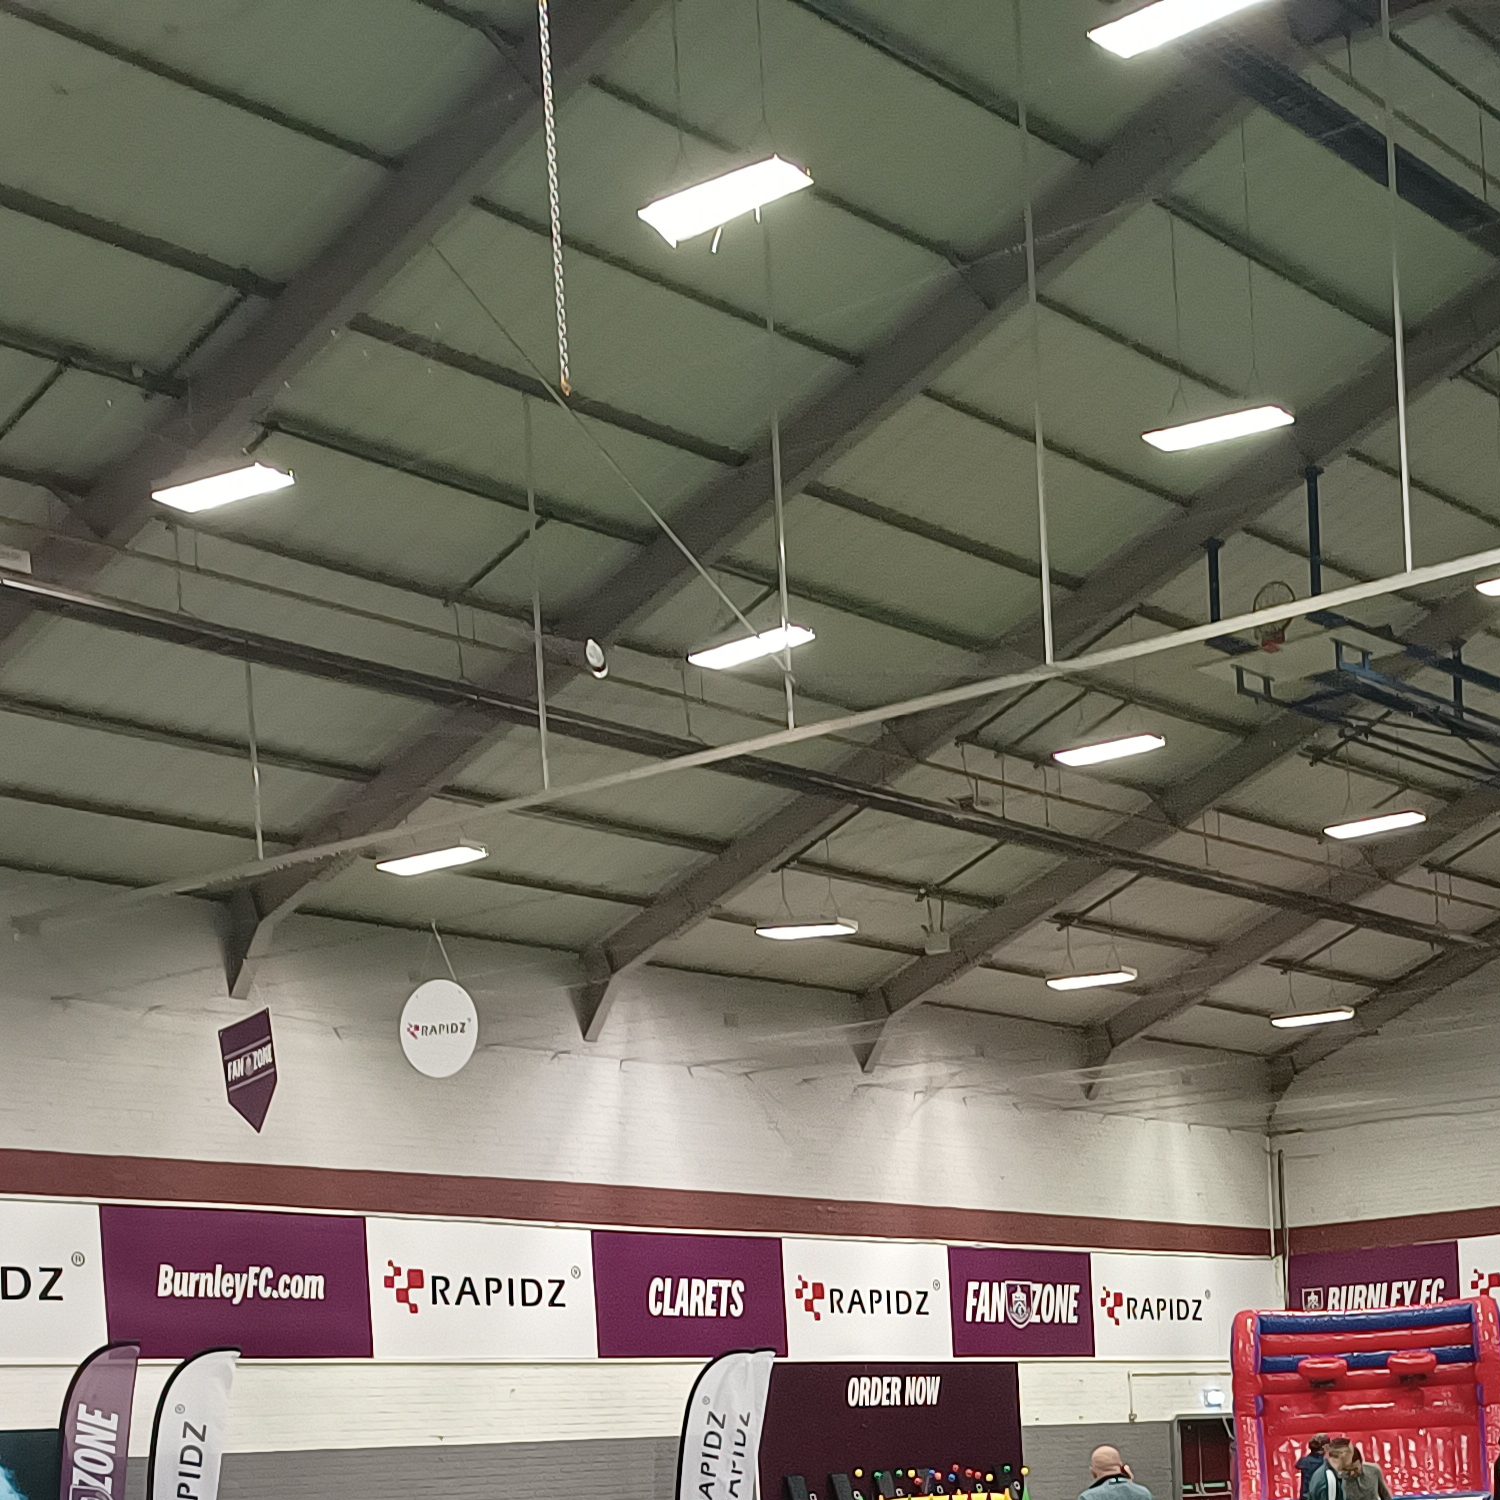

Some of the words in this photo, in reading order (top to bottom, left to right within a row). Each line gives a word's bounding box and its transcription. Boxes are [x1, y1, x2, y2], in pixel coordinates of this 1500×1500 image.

[420, 1021, 467, 1037] RAPIDZ
[157, 1263, 325, 1305] BurnleyFC.com
[430, 1274, 567, 1308] RAPIDZ
[648, 1276, 746, 1318] CLARETS
[828, 1284, 931, 1316] RAPIDZ
[1420, 1278, 1445, 1309] FC
[965, 1280, 1005, 1324] FAN
[1031, 1281, 1081, 1325] ZONE
[1125, 1291, 1203, 1321] RAPIDZ
[847, 1376, 899, 1407] ORDER
[901, 1375, 941, 1406] NOW
[73, 1402, 119, 1495] ZONE
